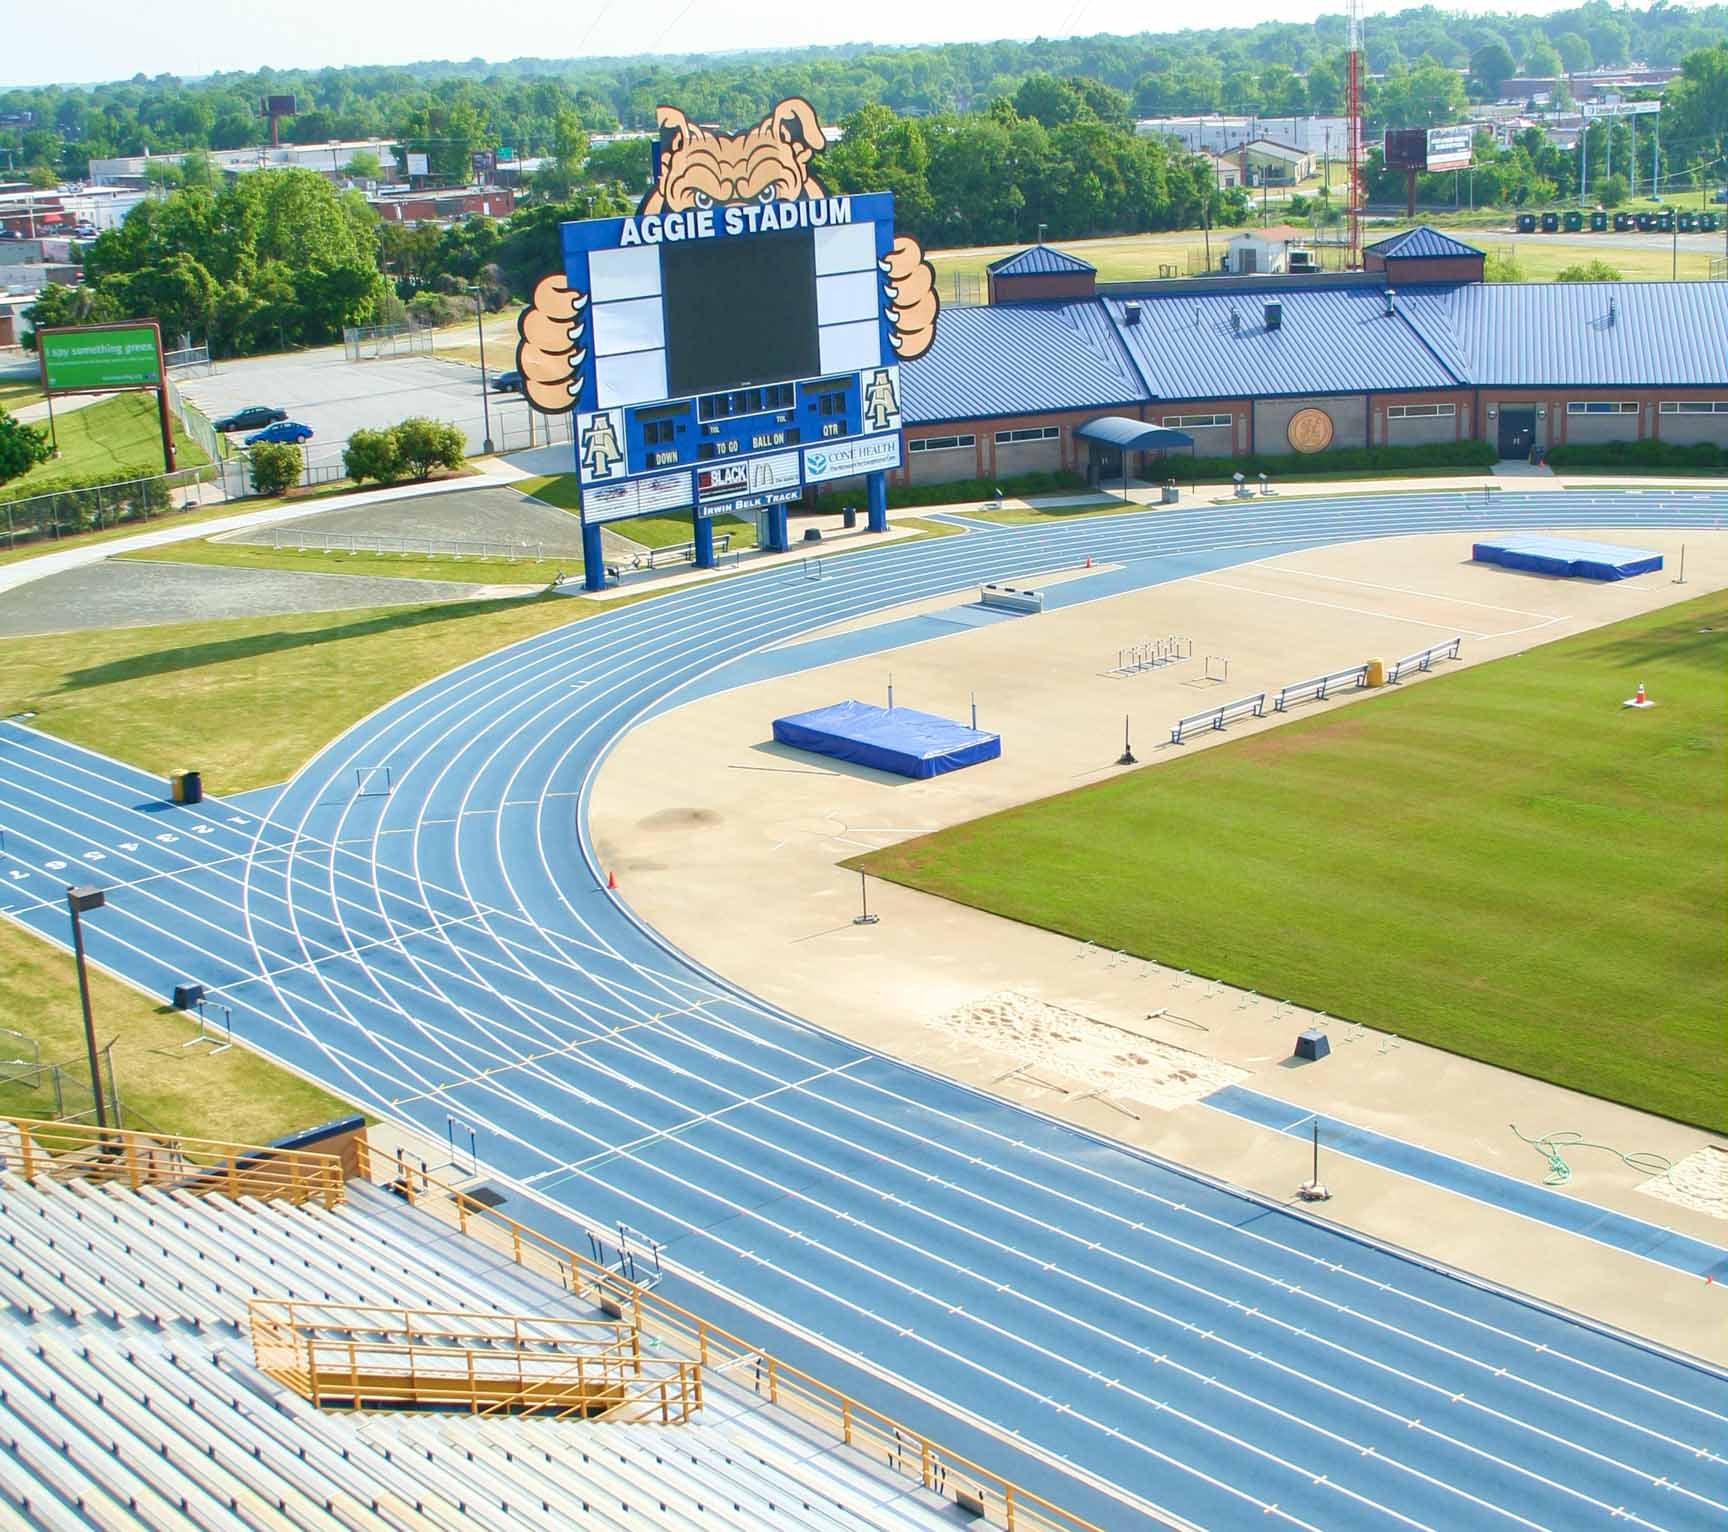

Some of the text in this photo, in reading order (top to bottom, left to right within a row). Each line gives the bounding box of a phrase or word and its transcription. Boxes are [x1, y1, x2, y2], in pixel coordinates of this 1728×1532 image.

[620, 198, 853, 247] AGGIE STADIUM
[51, 349, 69, 358] spy
[72, 343, 122, 355] something
[823, 424, 839, 437] QTR
[716, 441, 739, 455] TO GO
[752, 432, 785, 449] BALL ON
[656, 450, 679, 466] DOWN
[829, 442, 896, 463] CONE HEALTH
[711, 464, 747, 487] BLACK
[703, 491, 800, 516] IRWIN BELK TRACK
[191, 825, 215, 834] 2
[82, 851, 106, 861] 5
[8, 869, 32, 880] 7
